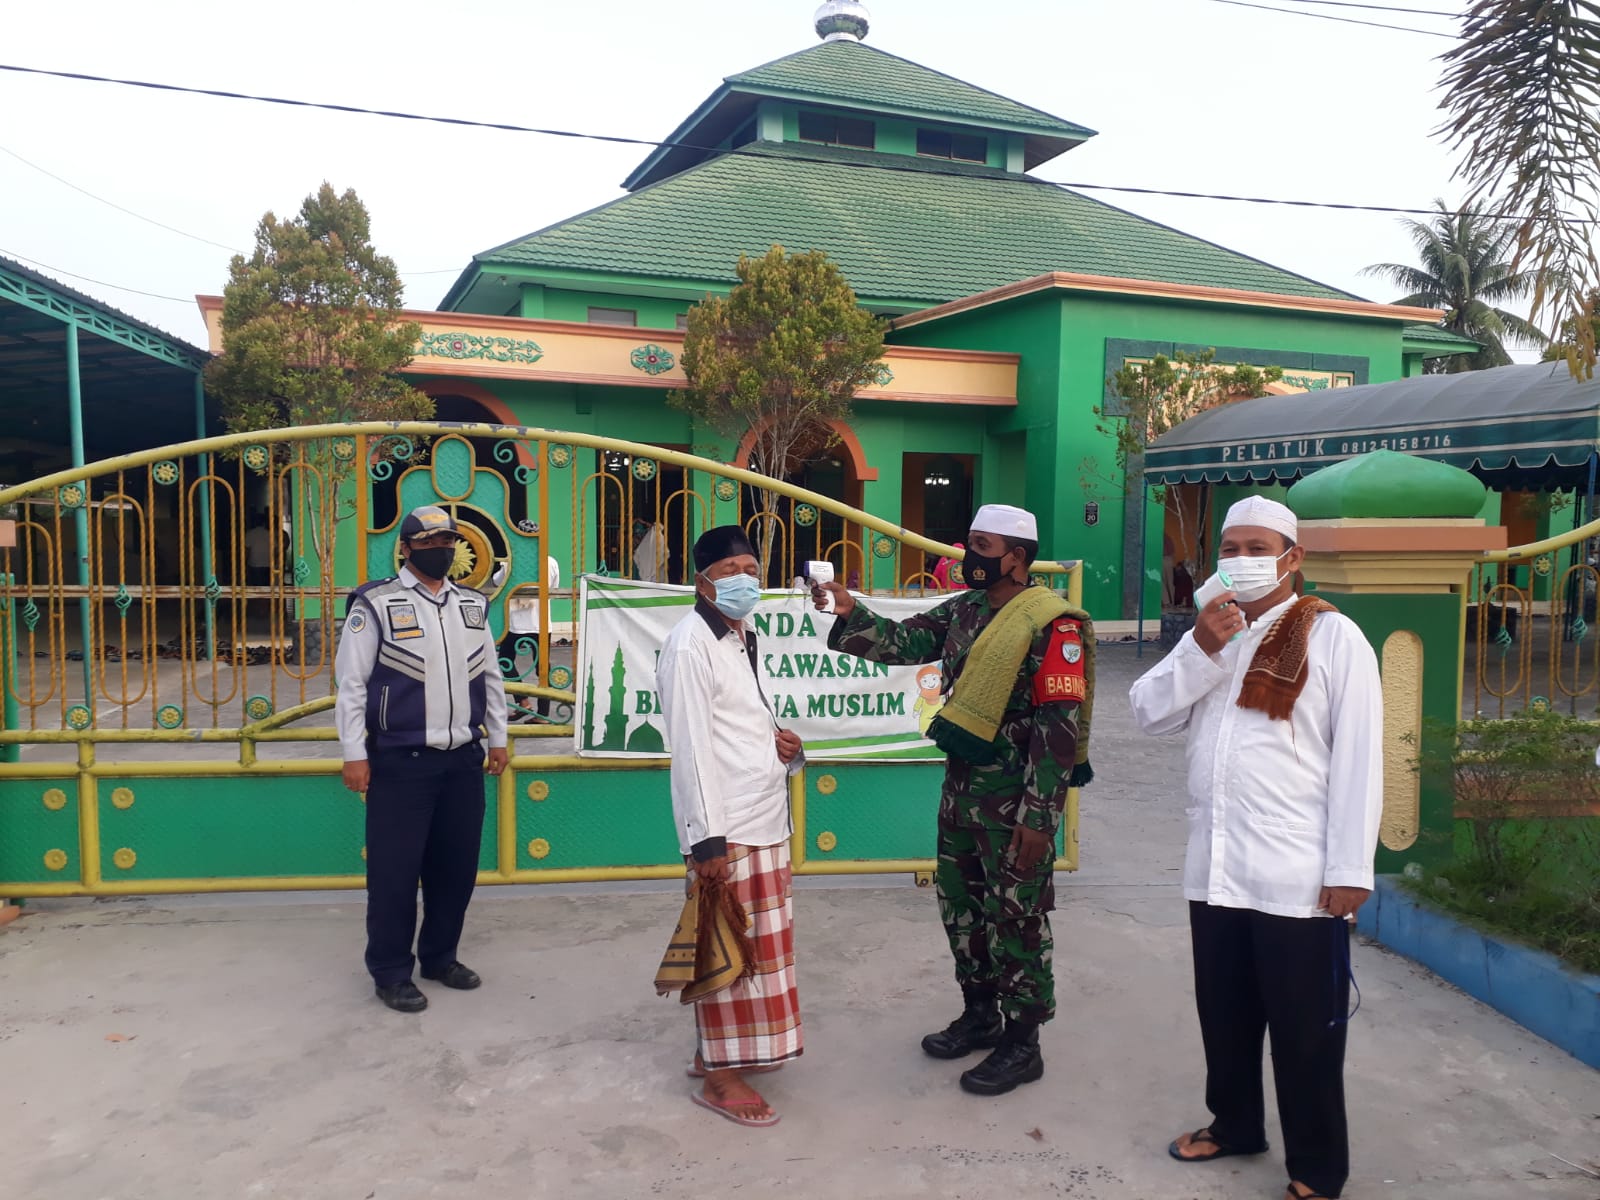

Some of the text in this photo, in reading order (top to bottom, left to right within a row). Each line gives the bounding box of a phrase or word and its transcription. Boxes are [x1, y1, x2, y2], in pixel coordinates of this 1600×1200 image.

[1222, 435, 1451, 462] PELATUK 08125158716
[753, 612, 817, 637] NDA
[806, 691, 906, 718] MUSLIM
